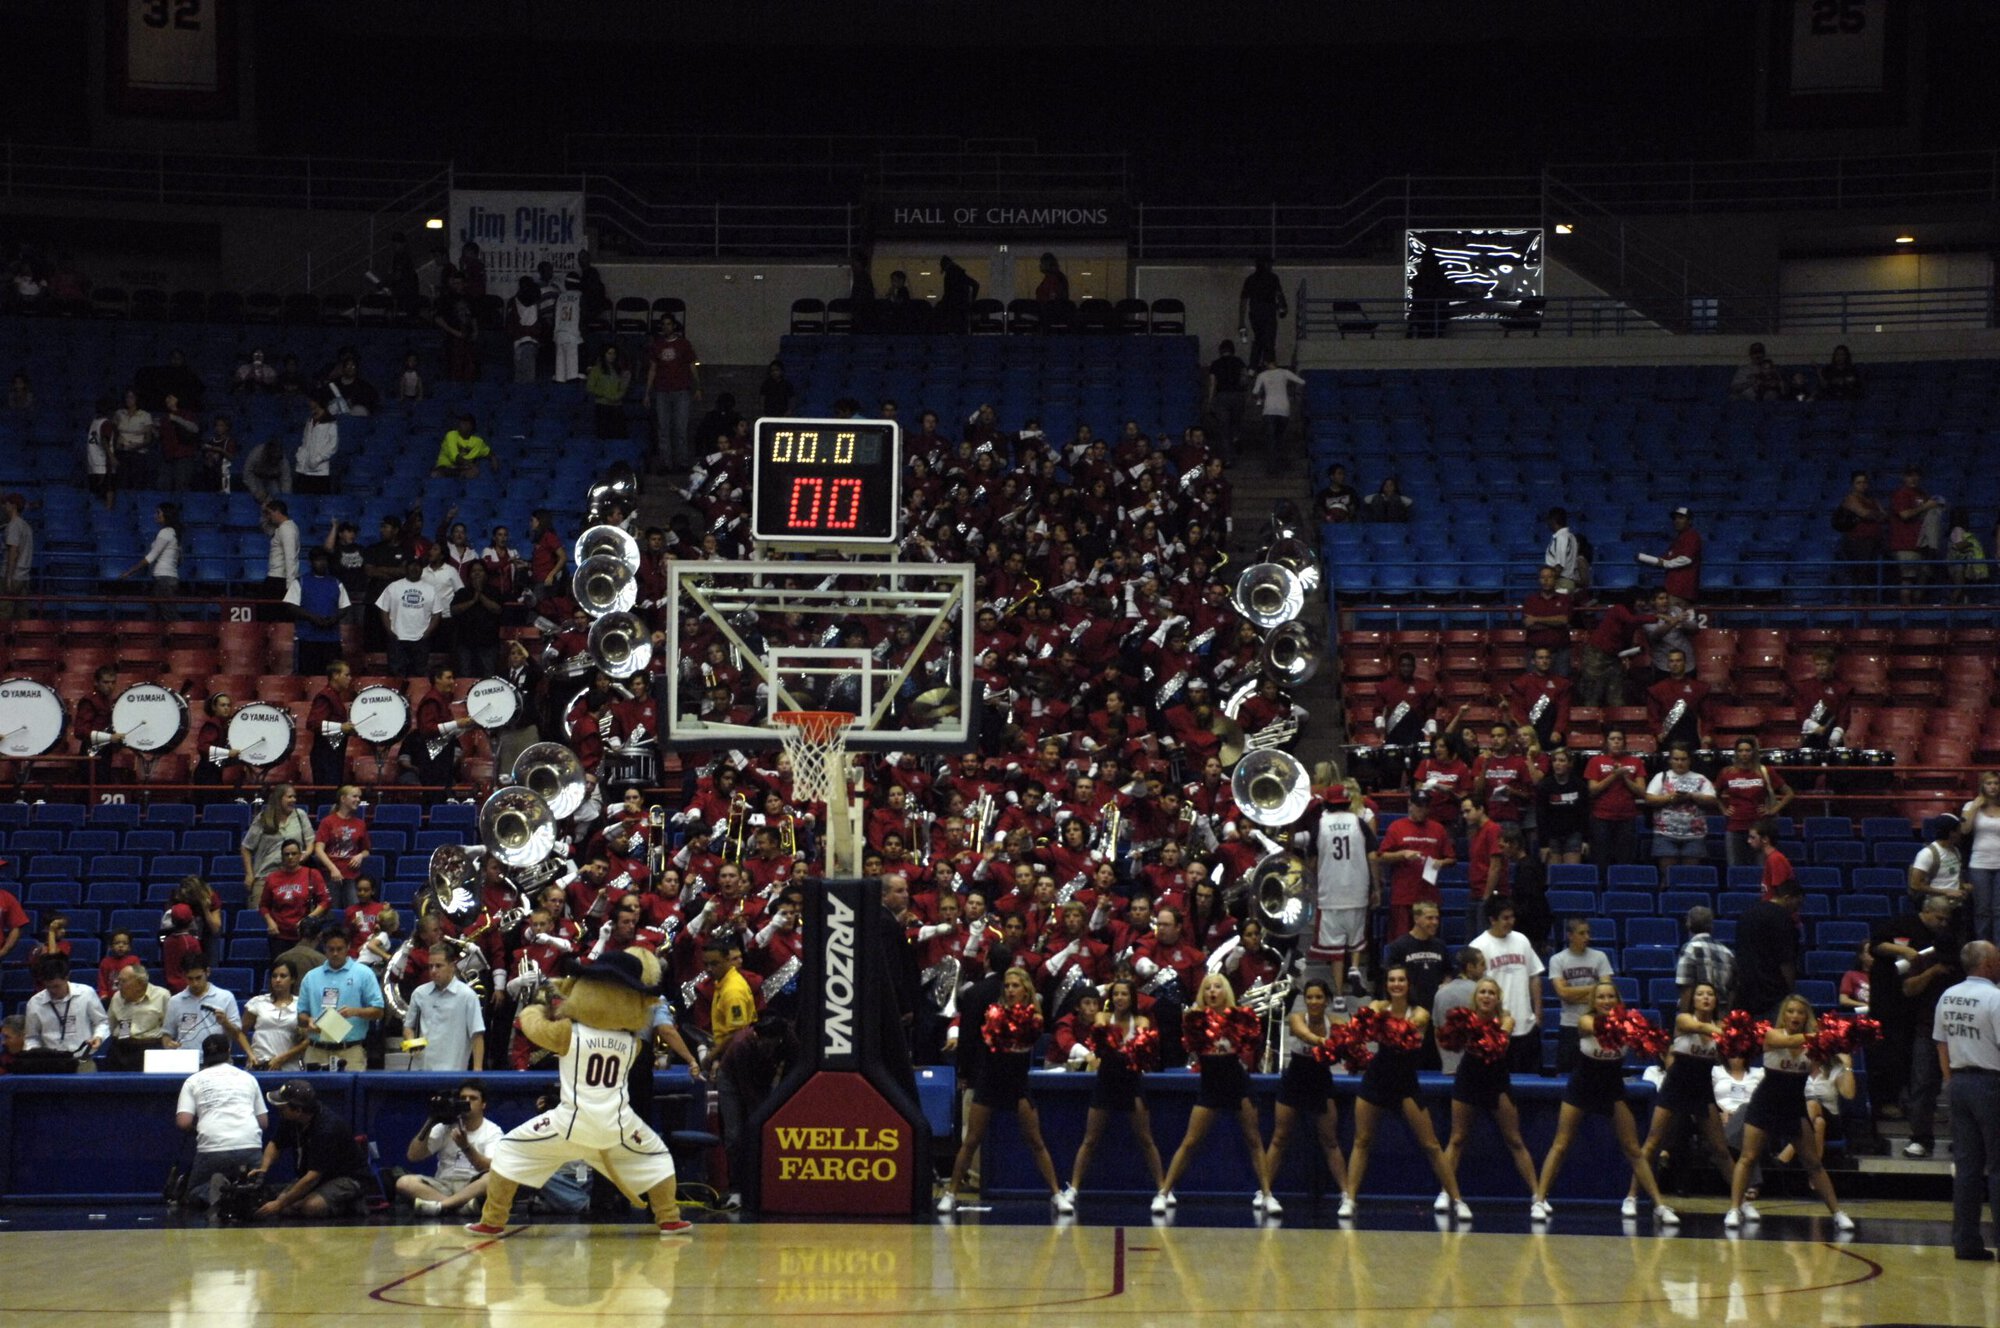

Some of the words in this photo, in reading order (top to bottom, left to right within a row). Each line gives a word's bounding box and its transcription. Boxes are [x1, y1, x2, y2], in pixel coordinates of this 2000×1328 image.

[143, 0, 200, 29] 32
[1812, 0, 1866, 34] 25
[894, 207, 946, 224] HALL
[953, 207, 979, 224] OF
[985, 207, 1109, 224] CHAMPIONS
[461, 206, 505, 243] Jim
[515, 206, 575, 244] Click
[772, 431, 856, 464] 00.0
[787, 477, 863, 528] 00
[230, 606, 252, 622] 20
[11, 689, 41, 698] YAMAHA
[136, 693, 166, 702] YAMAHA
[480, 685, 505, 696] YAMAHA
[368, 695, 392, 704] YAMAHA
[249, 713, 279, 722] YAMAHA
[1332, 835, 1351, 860] 31
[1405, 950, 1443, 963] ARIZONA
[1489, 953, 1527, 970] ARIZONA
[824, 892, 855, 1059] ARIZONA
[1562, 965, 1600, 980] ARIZONA
[1942, 995, 1980, 1008] EVENT
[1943, 1010, 1975, 1023] STAFF
[586, 1036, 628, 1055] WILBUR
[585, 1053, 620, 1088] 00
[775, 1127, 900, 1153] WELLS
[777, 1156, 897, 1182] FARGO
